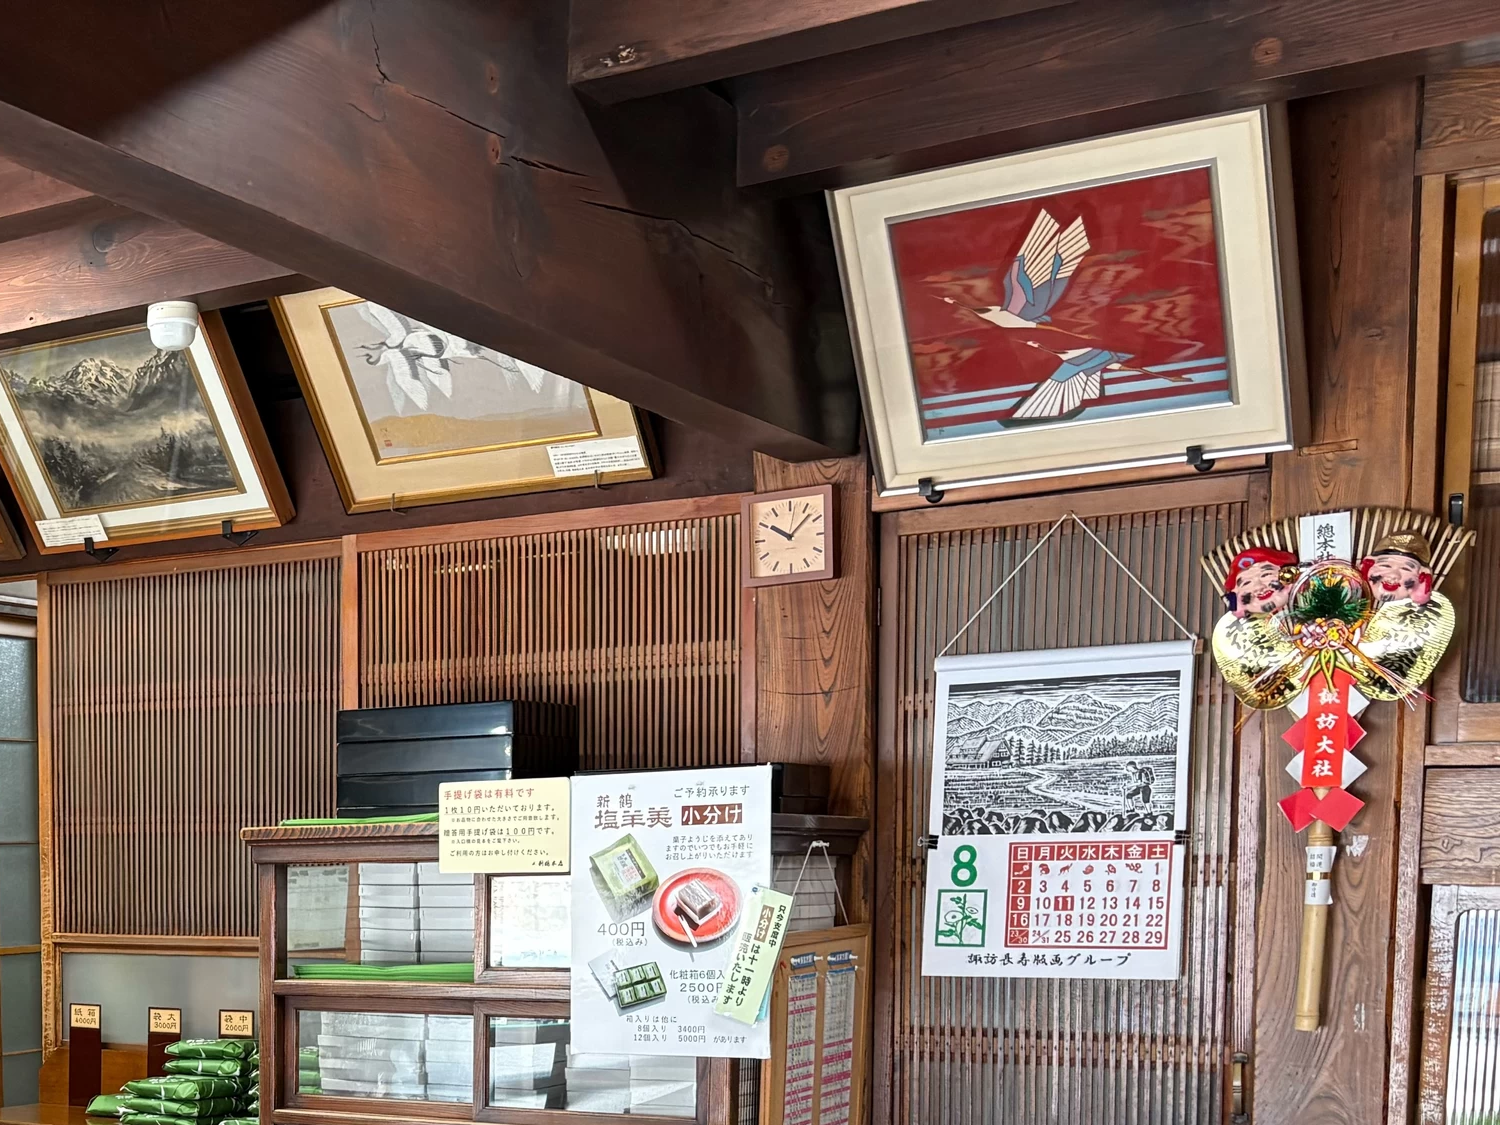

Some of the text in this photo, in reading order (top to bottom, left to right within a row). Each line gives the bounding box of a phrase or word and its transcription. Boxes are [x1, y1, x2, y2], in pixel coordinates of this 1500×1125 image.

[1311, 688, 1340, 779] 諏訪大社
[444, 788, 534, 801] 手提げ袋は有料です
[674, 785, 749, 799] ご予約承ります
[597, 793, 632, 808] 新鶴
[444, 804, 555, 815] 1枚10円いただいております。
[683, 806, 743, 826] 小分け
[672, 834, 753, 845] 菓子ようじを添えてあり
[450, 849, 549, 857] ご利用の方はお申し付けください。
[666, 843, 753, 852] ますのでいつでもお手軽に
[1017, 846, 1166, 860] 日 月 火 水 木 金 土
[666, 852, 753, 861] お召し上がりいただけます
[950, 844, 978, 888] 8
[1154, 863, 1160, 875] 1
[1017, 880, 1160, 892] 2 3 4 5 6 7 8
[1017, 897, 1164, 910] 9 10 11 12 13 14 15
[1012, 913, 1163, 926] 16 17 18 19 20 21 22
[597, 921, 645, 936] 400円
[1055, 931, 1163, 944] 25 26 27 28 29
[669, 969, 726, 981] 化粧箱6個入
[626, 1014, 677, 1024] 箱入りは他に
[637, 1024, 705, 1034] 8個入り 3400円
[634, 1033, 747, 1044] 12個入り 5000円 があります
